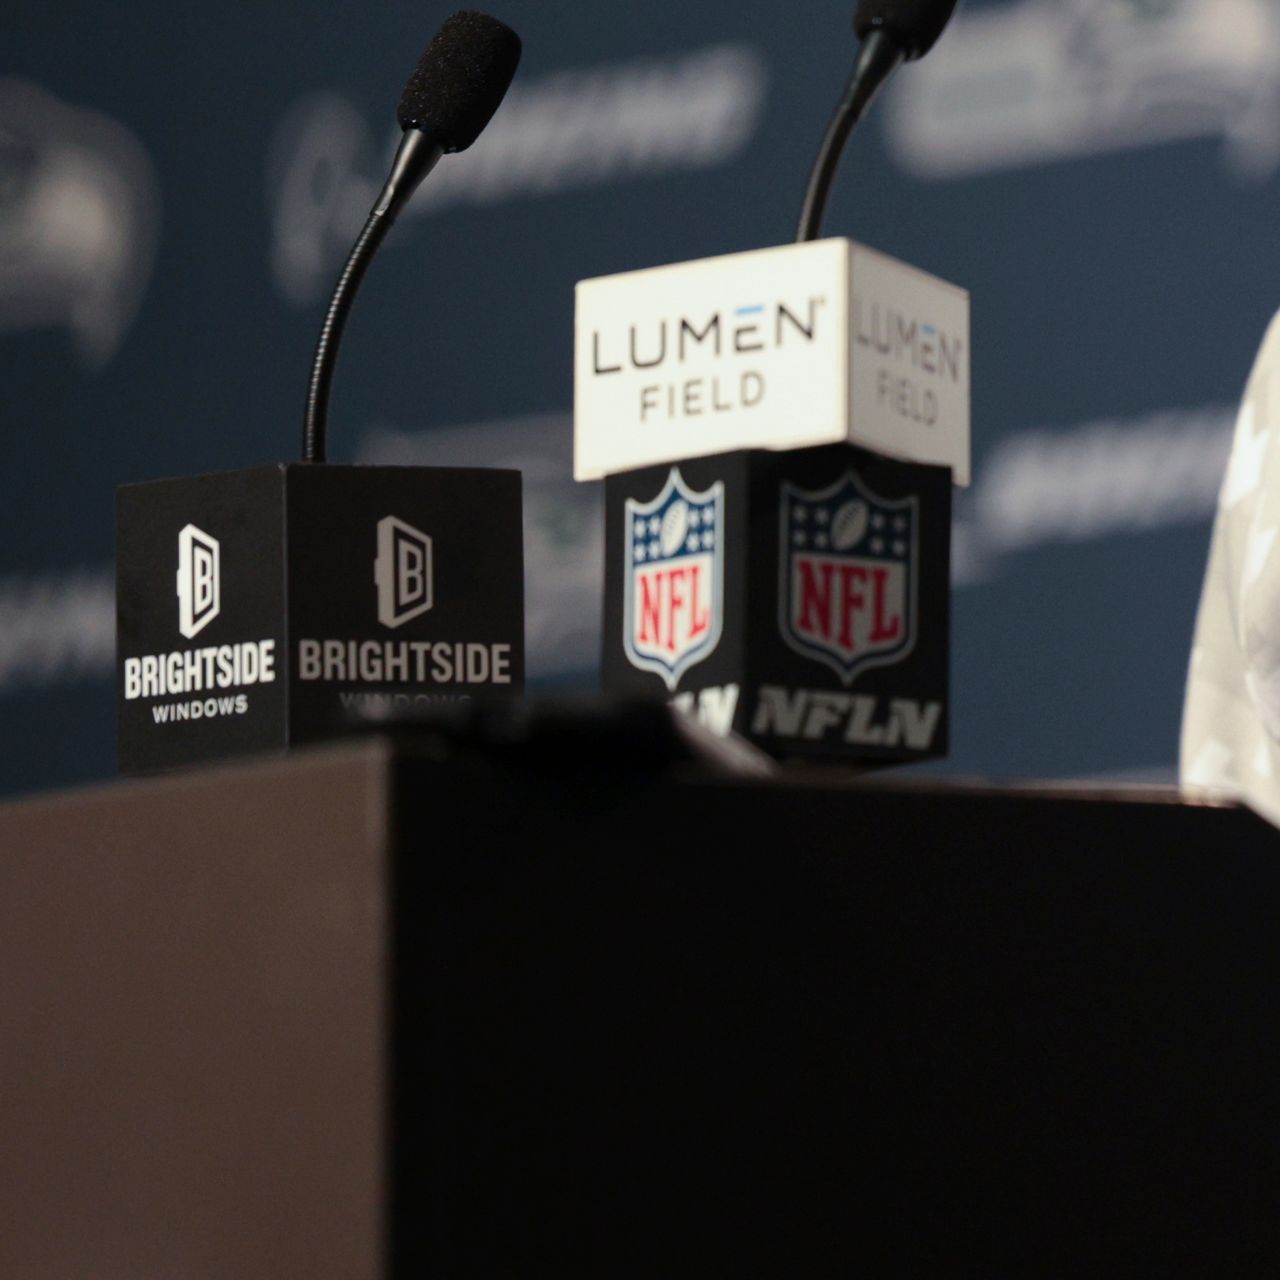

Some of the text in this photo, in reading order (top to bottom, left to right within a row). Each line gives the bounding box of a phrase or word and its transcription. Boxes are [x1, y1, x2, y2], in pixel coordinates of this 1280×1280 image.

[639, 370, 766, 423] FIELD
[876, 368, 938, 426] FIELD
[637, 565, 709, 651] NFL
[795, 558, 903, 652] NFL
[124, 639, 275, 700] BRIGHTSIDE
[299, 639, 511, 684] BRIGHTSIDE
[152, 694, 248, 724] WINDOWS
[752, 685, 942, 750] NFLN
